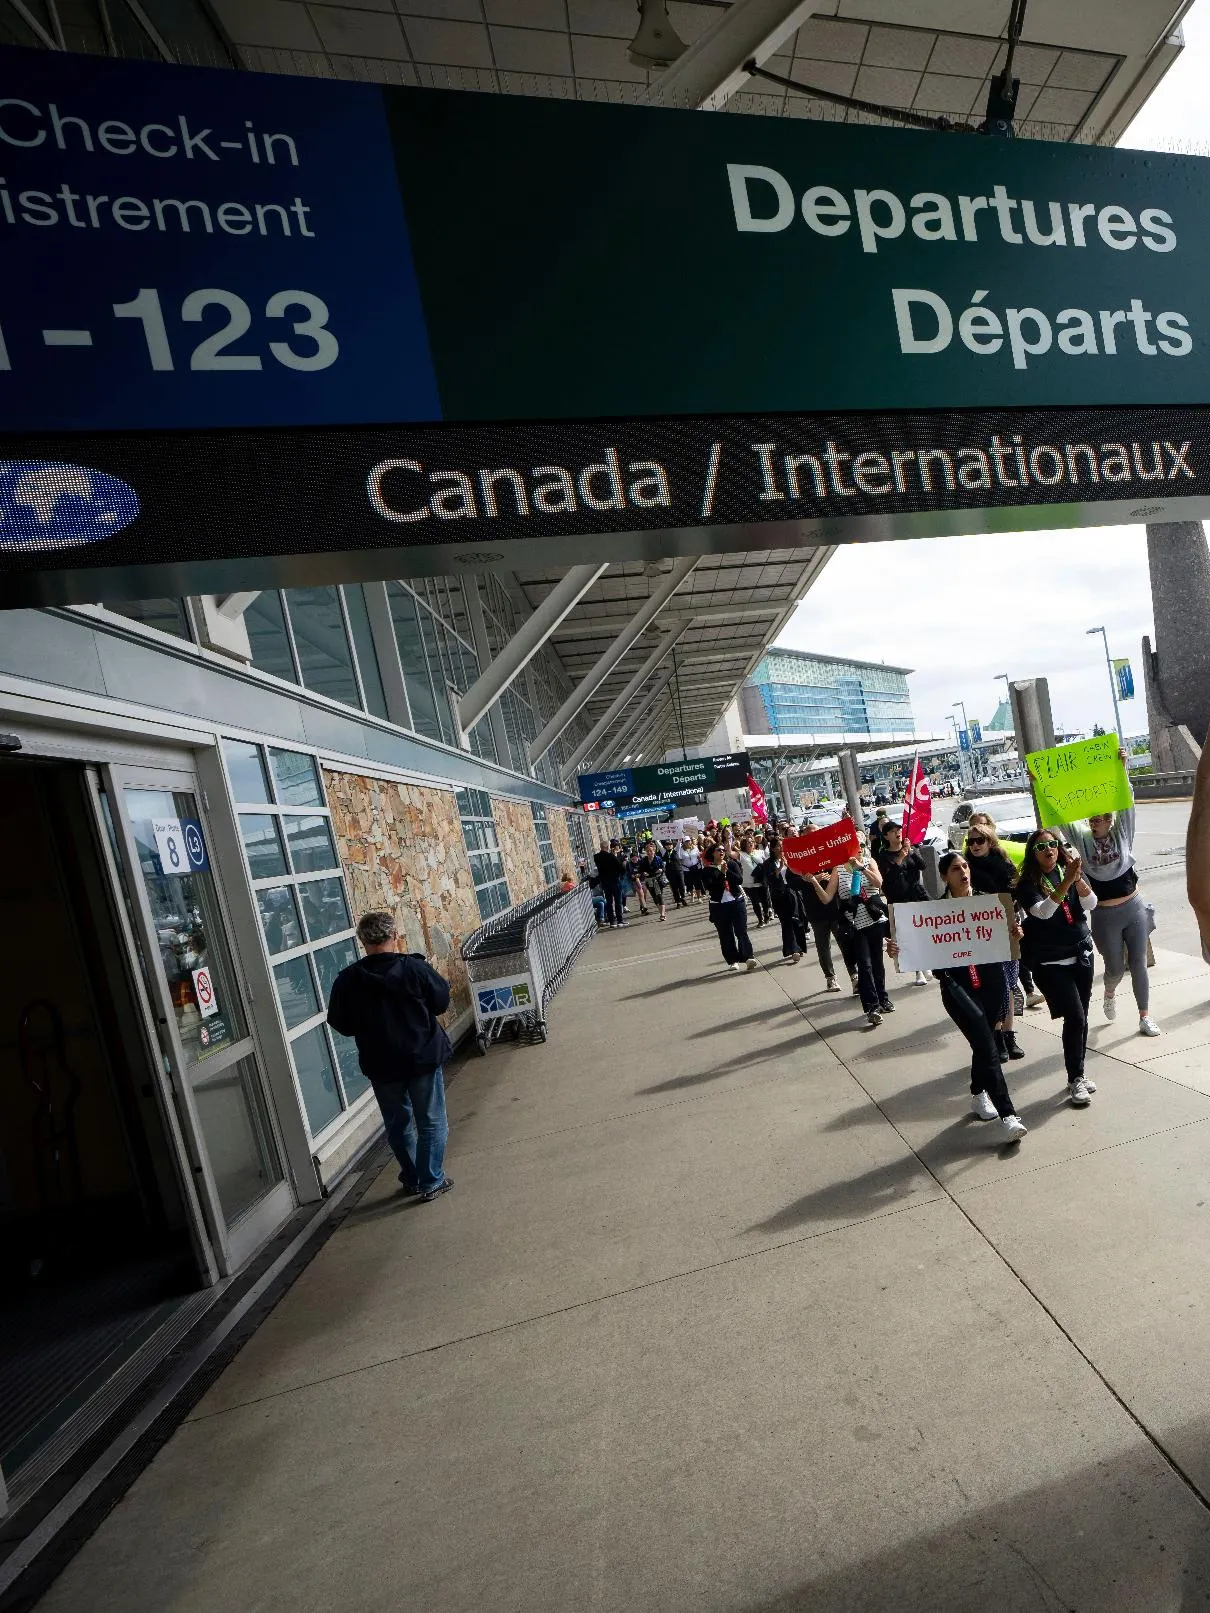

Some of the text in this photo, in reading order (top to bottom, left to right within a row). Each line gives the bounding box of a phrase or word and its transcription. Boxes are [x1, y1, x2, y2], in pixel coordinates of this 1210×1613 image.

[725, 163, 1178, 254] Departures
[891, 287, 1194, 370] Départs
[365, 446, 672, 524] Canada
[751, 434, 1198, 502] Internationaux
[657, 762, 705, 776] Departures
[166, 836, 180, 868] 8
[786, 845, 817, 860] Unpaid
[826, 833, 852, 849] Unfair
[912, 907, 1003, 929] Unpaid work
[932, 925, 993, 944] won't fly
